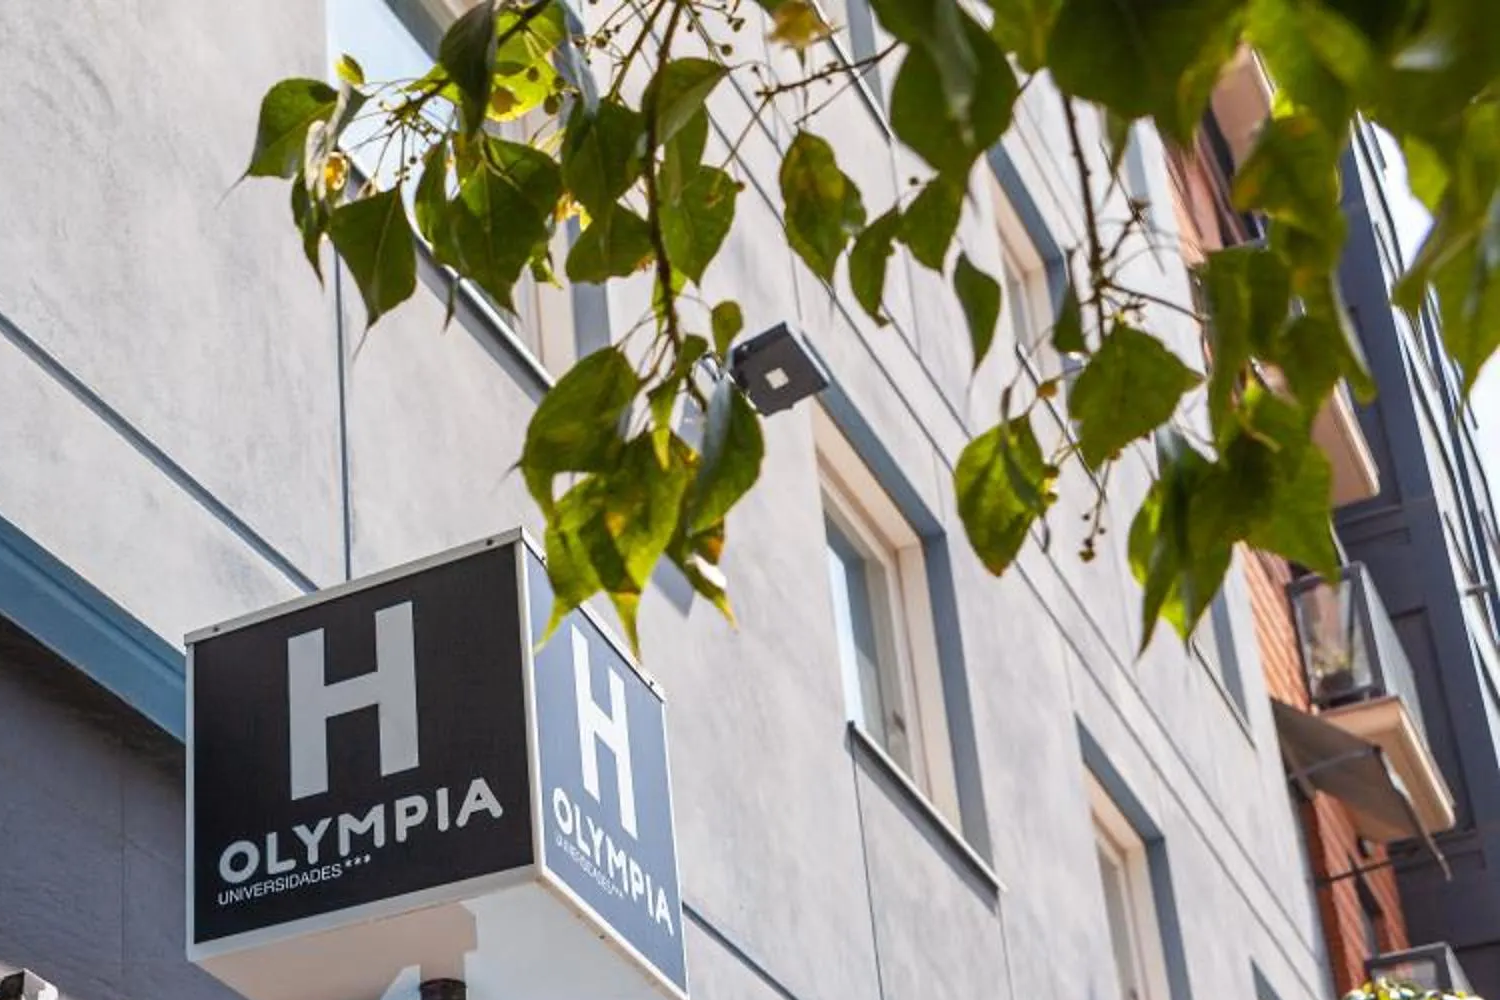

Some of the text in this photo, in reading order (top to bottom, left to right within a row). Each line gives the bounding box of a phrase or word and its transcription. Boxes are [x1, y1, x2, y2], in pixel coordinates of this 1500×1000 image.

[287, 600, 420, 800] H
[571, 624, 638, 840] H
[218, 777, 504, 883] OLYMPIA
[218, 864, 342, 905] UNIVERSIDADES
[552, 787, 674, 936] OLYMPIA
